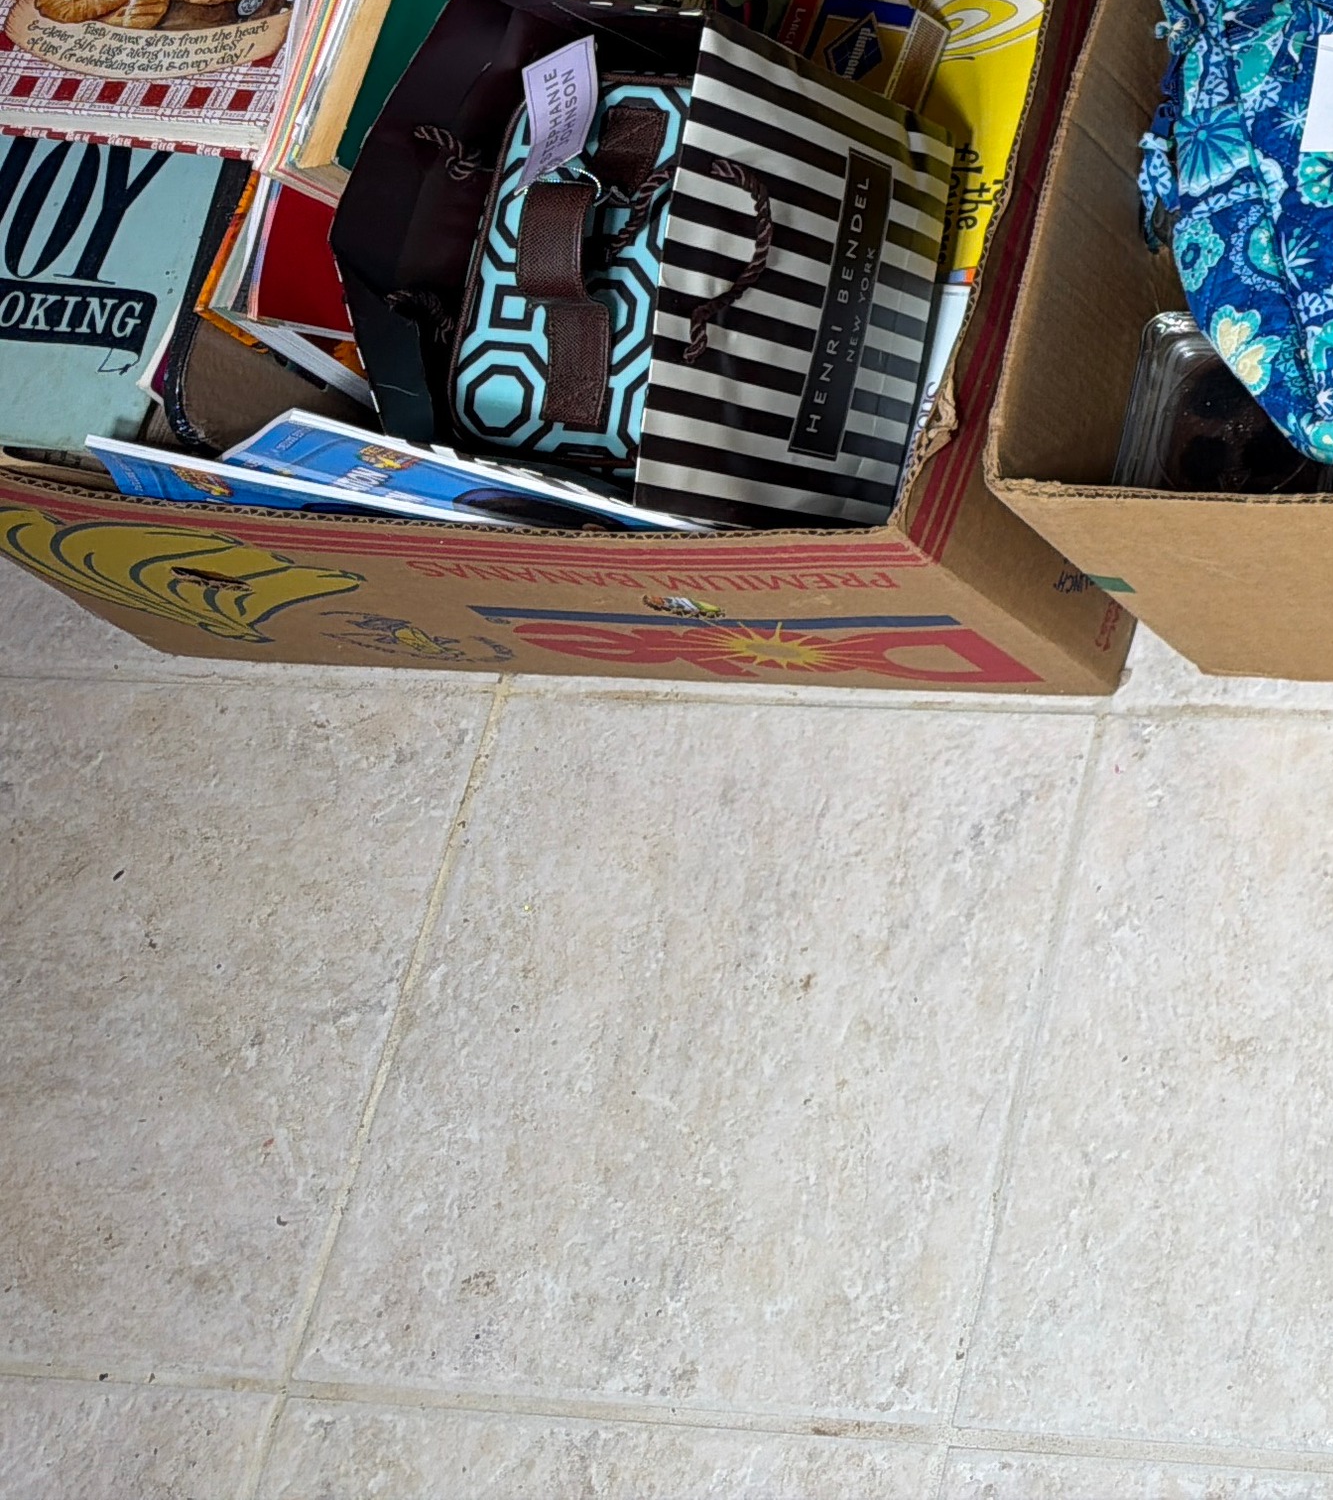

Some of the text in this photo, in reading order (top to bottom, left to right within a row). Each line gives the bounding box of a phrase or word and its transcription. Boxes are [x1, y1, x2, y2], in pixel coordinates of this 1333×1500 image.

[558, 68, 577, 145] JOHNSON
[0, 290, 142, 340] OKING
[804, 175, 870, 434] HENRI BENDEL
[845, 247, 876, 363] NEW YORK
[402, 559, 899, 593] PREMIUM BANANAS
